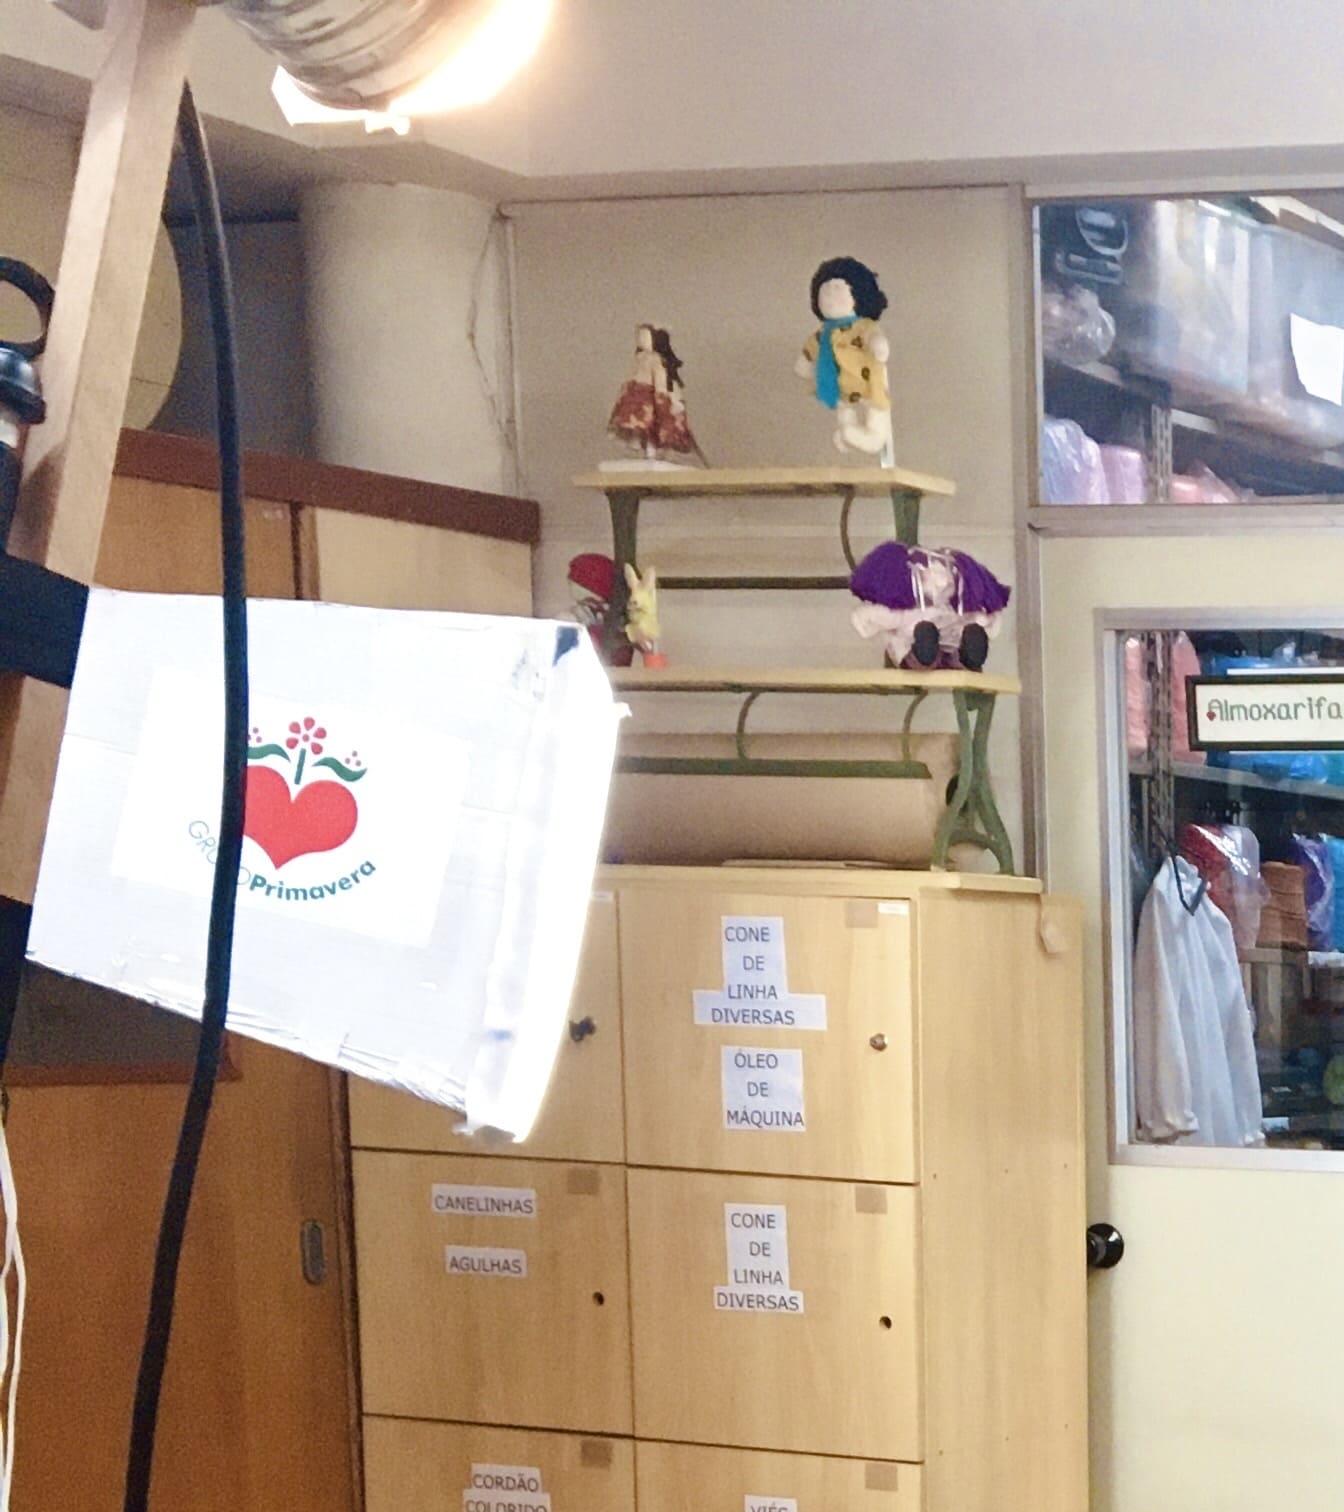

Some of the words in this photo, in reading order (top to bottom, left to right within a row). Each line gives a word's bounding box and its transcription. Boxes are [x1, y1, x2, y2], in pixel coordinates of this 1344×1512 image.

[188, 820, 251, 885] GRUO
[249, 860, 377, 901] Primavera
[724, 926, 770, 942] CONE
[743, 955, 765, 971] DE
[727, 984, 778, 1000] LINHA
[711, 1007, 795, 1025] DIVERSAS
[734, 1048, 778, 1069] ÓLEO
[747, 1081, 769, 1097] DE
[726, 1106, 804, 1128] MÁQUINA
[434, 1195, 534, 1214] CANELINHAS
[731, 1212, 776, 1229] CONE
[749, 1241, 771, 1257] DE
[450, 1256, 522, 1274] AGULHAS
[733, 1269, 784, 1285] LINHA
[716, 1292, 800, 1311] DIVERSAS
[472, 1473, 539, 1493] CORDÃO
